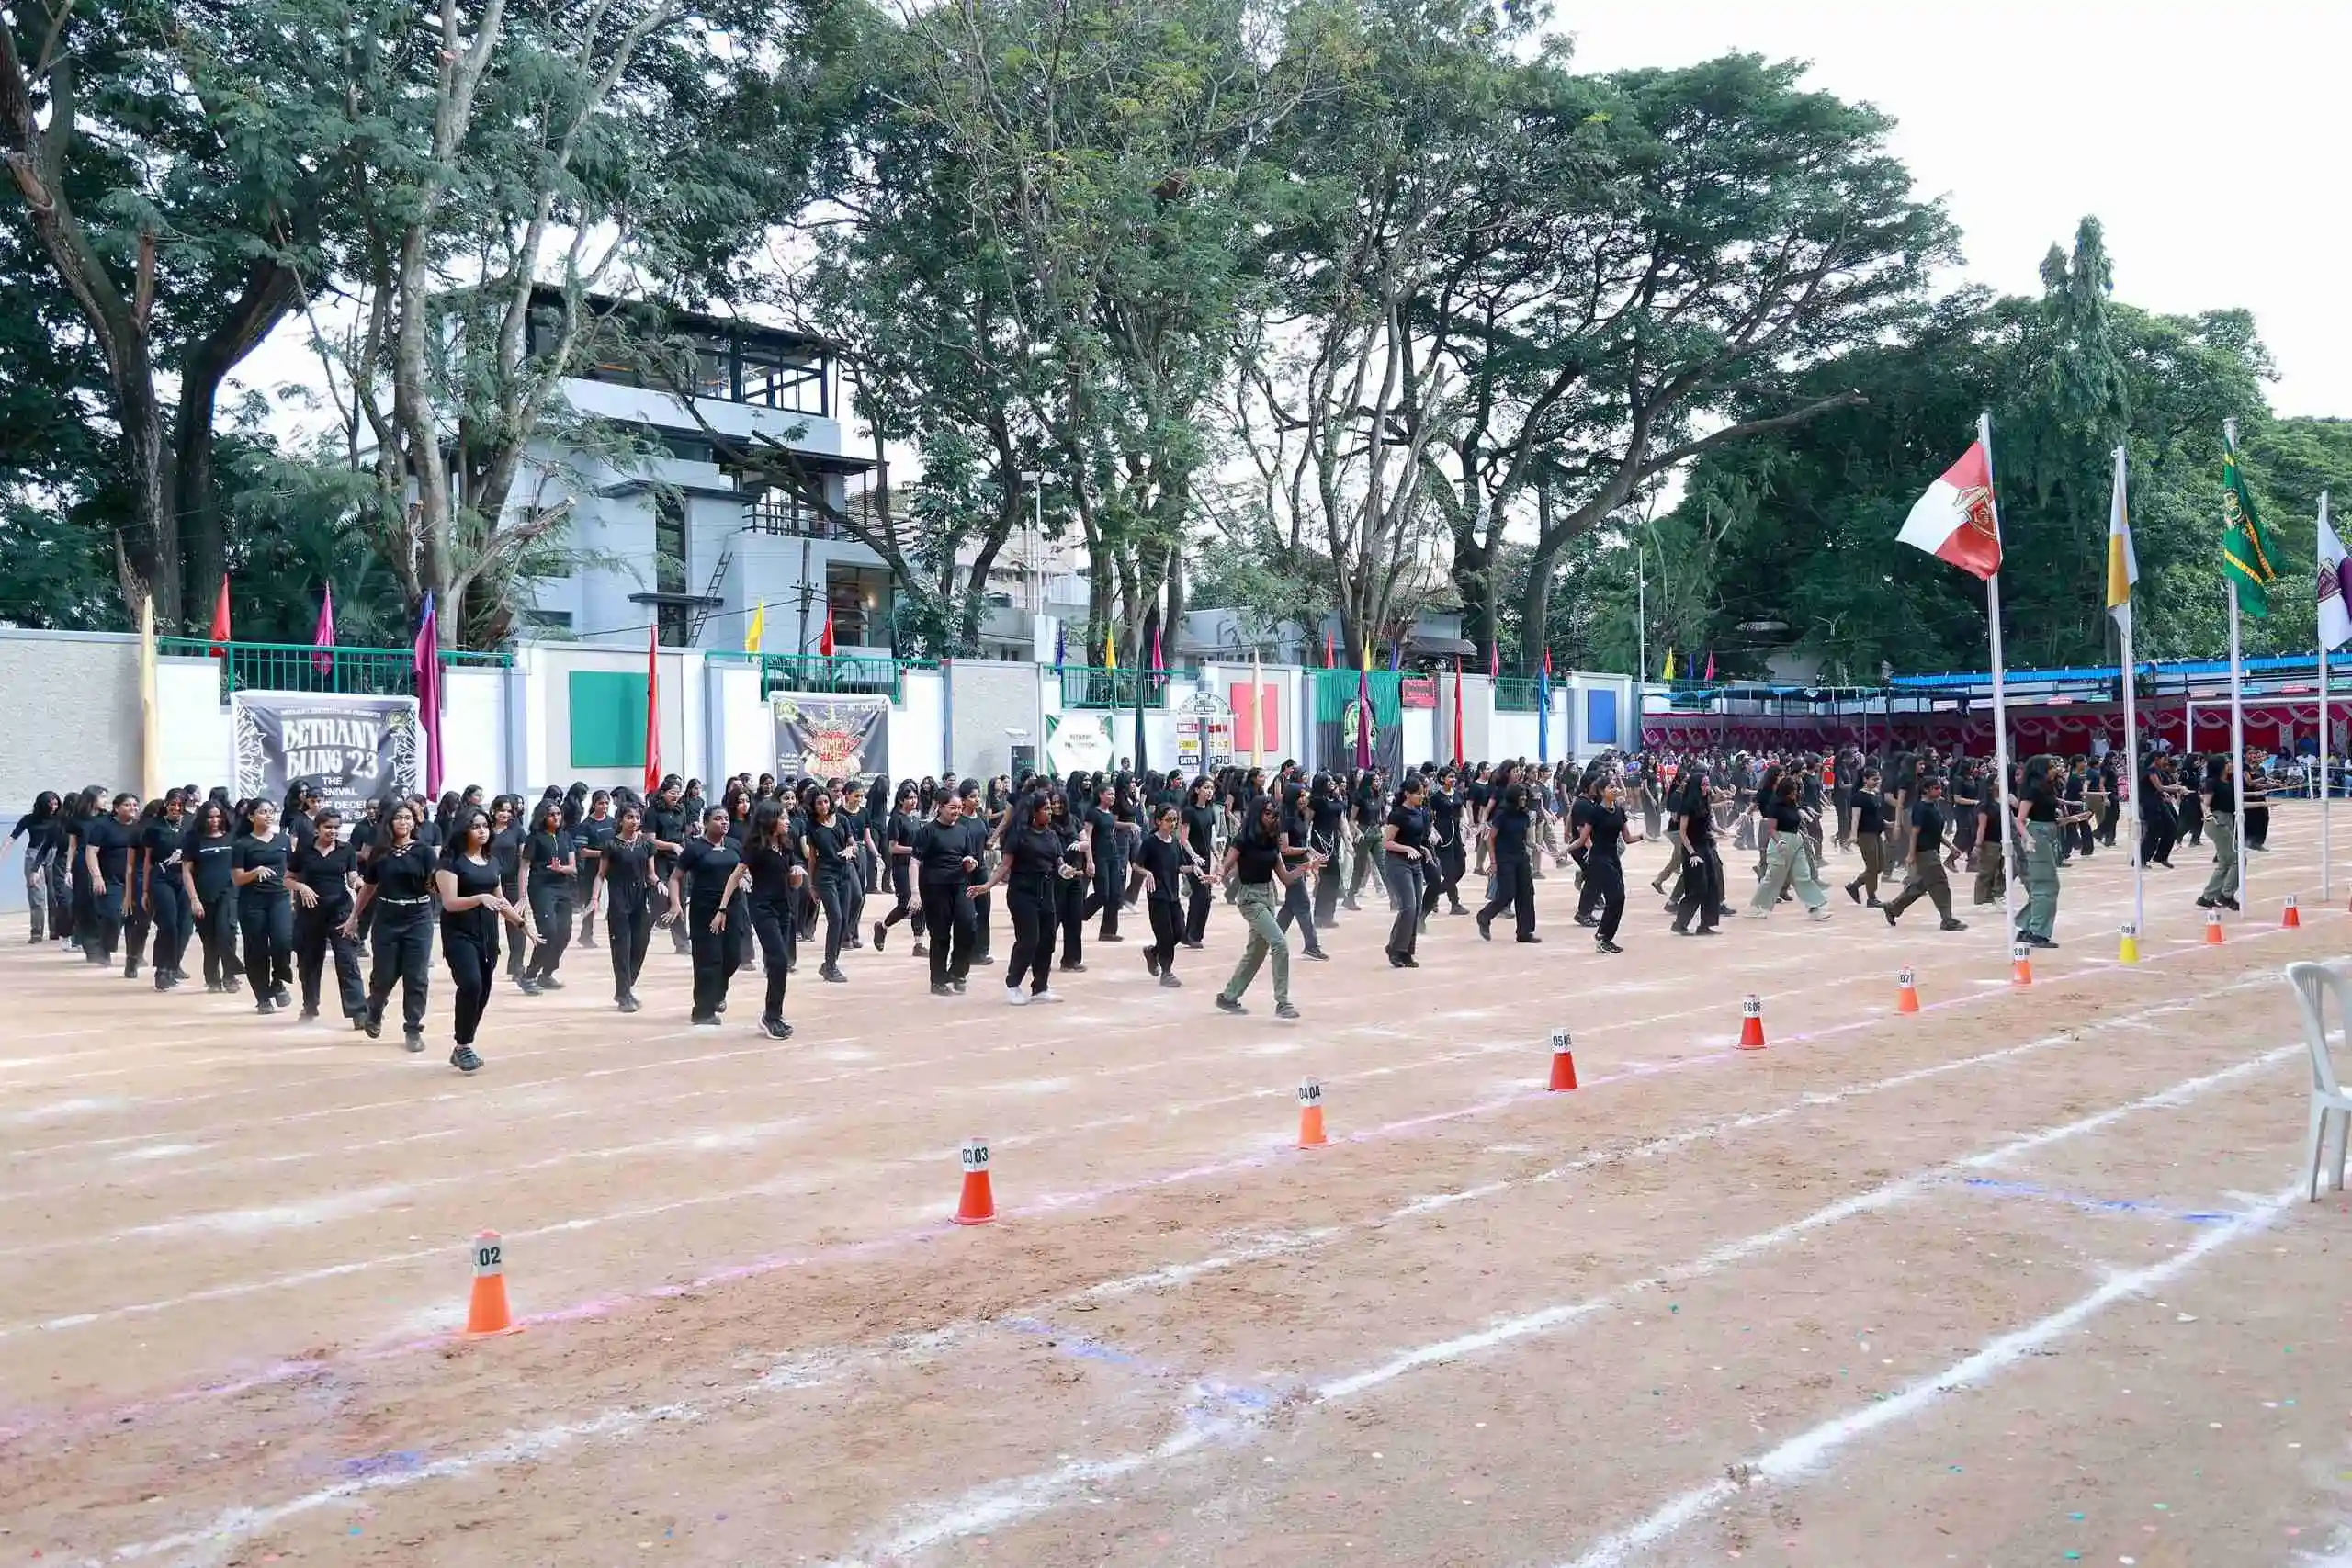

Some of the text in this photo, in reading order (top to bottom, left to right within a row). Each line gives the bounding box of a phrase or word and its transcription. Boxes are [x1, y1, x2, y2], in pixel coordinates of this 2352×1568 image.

[280, 718, 381, 753] BETHANY
[286, 749, 379, 781] BLING '23
[322, 776, 344, 785] THE
[1900, 974, 1911, 983] 07
[1743, 1001, 1752, 1012] 06
[1553, 1035, 1563, 1047] 05
[1309, 1085, 1320, 1099] 04
[962, 1146, 989, 1164] 03 03
[479, 1246, 502, 1266] 02
